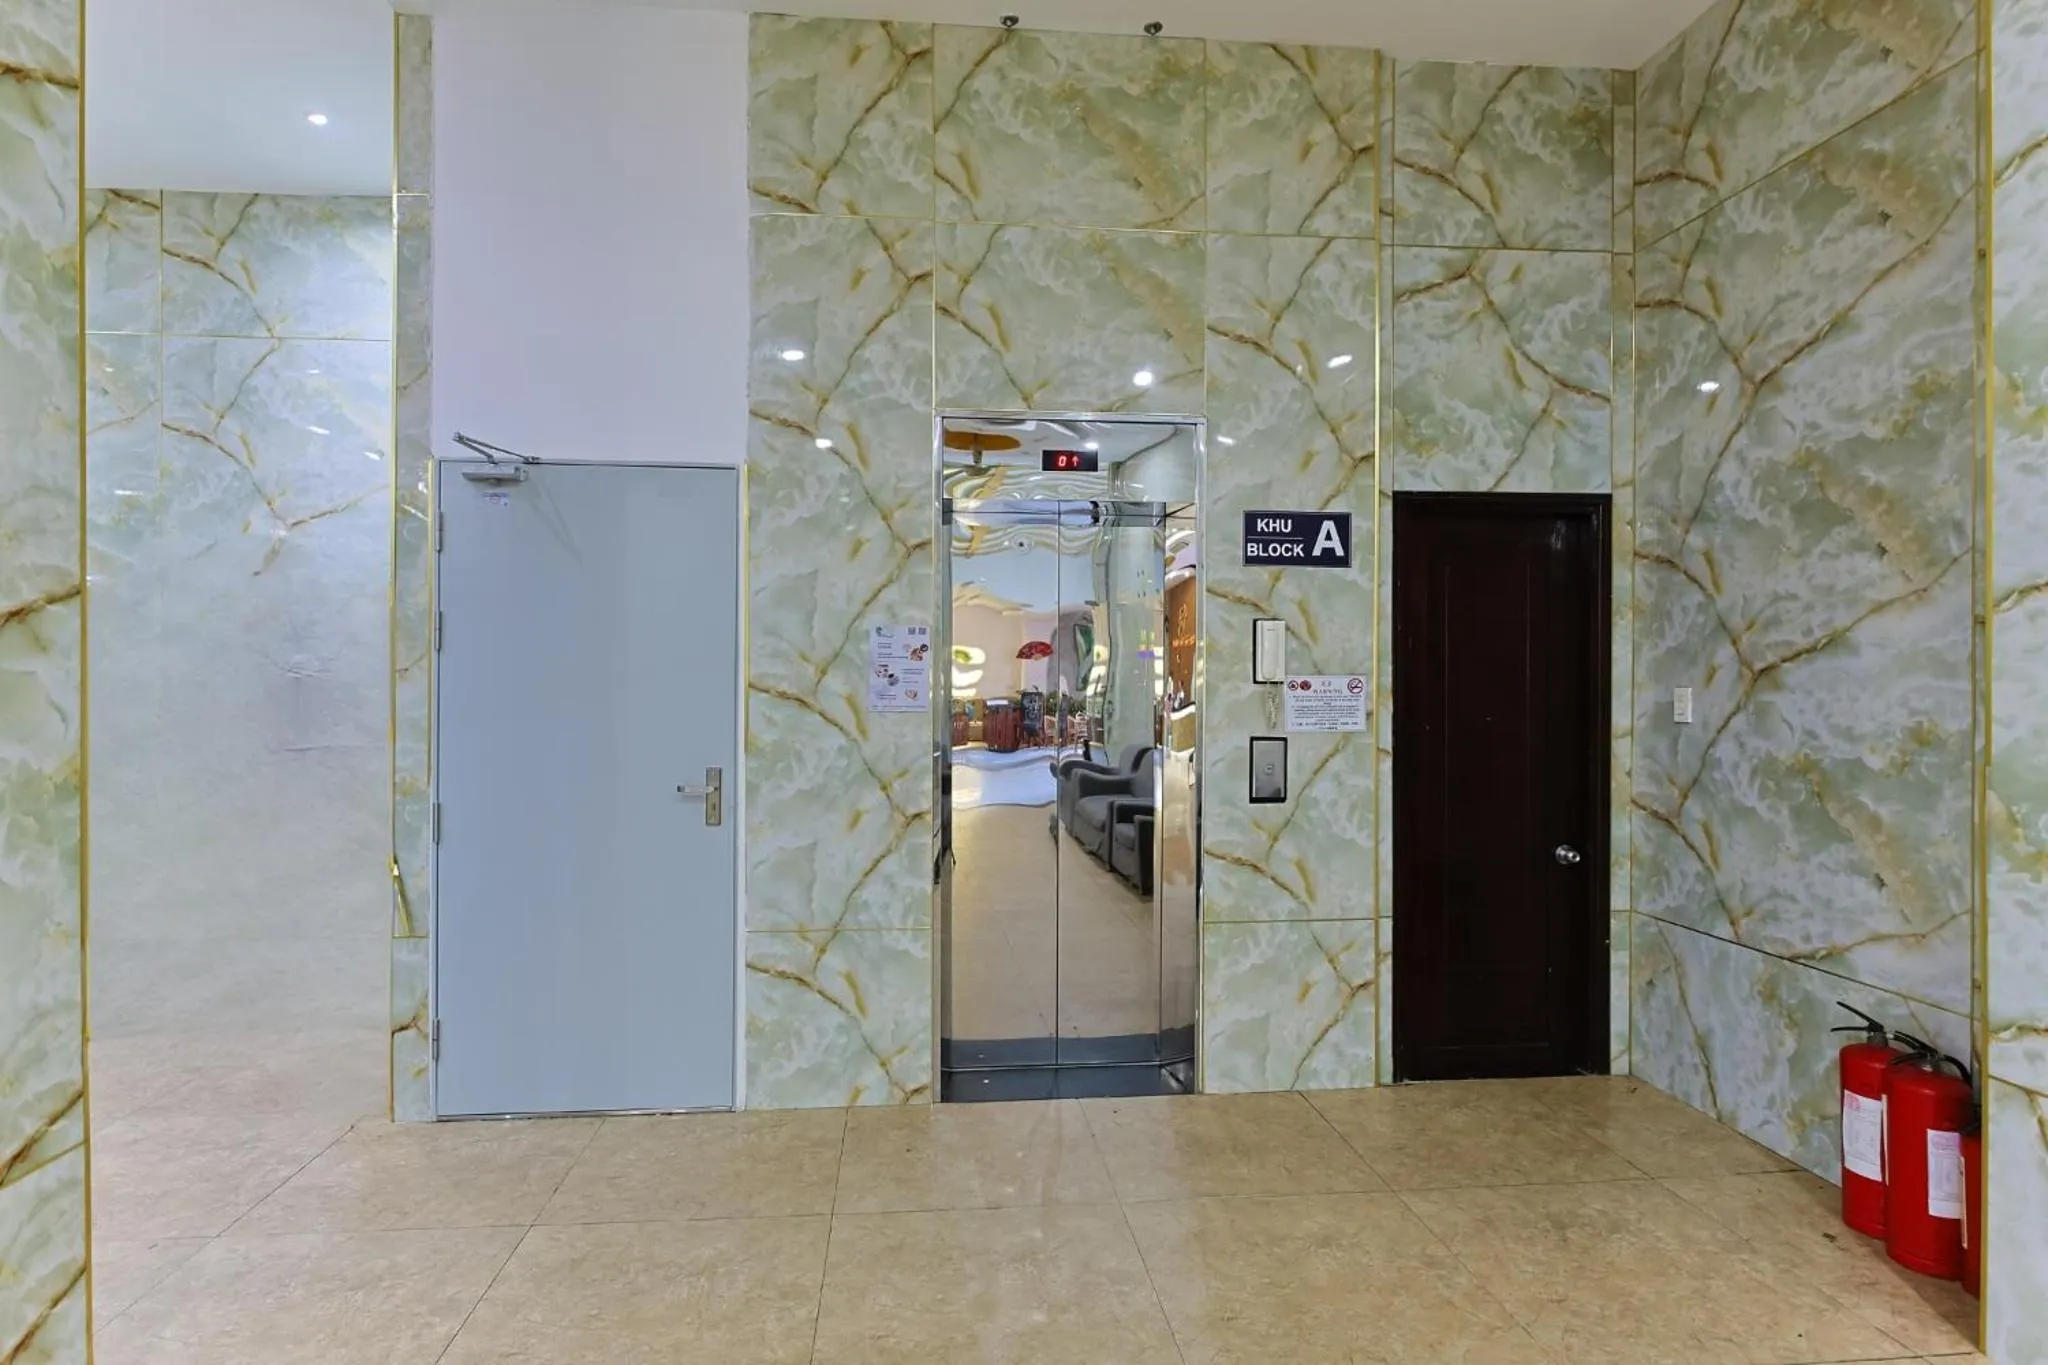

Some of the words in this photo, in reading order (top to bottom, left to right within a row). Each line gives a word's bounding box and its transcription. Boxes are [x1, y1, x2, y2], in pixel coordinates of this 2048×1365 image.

[1256, 518, 1292, 533] KHU
[1311, 519, 1345, 557] A
[1247, 542, 1305, 557] BLOCK
